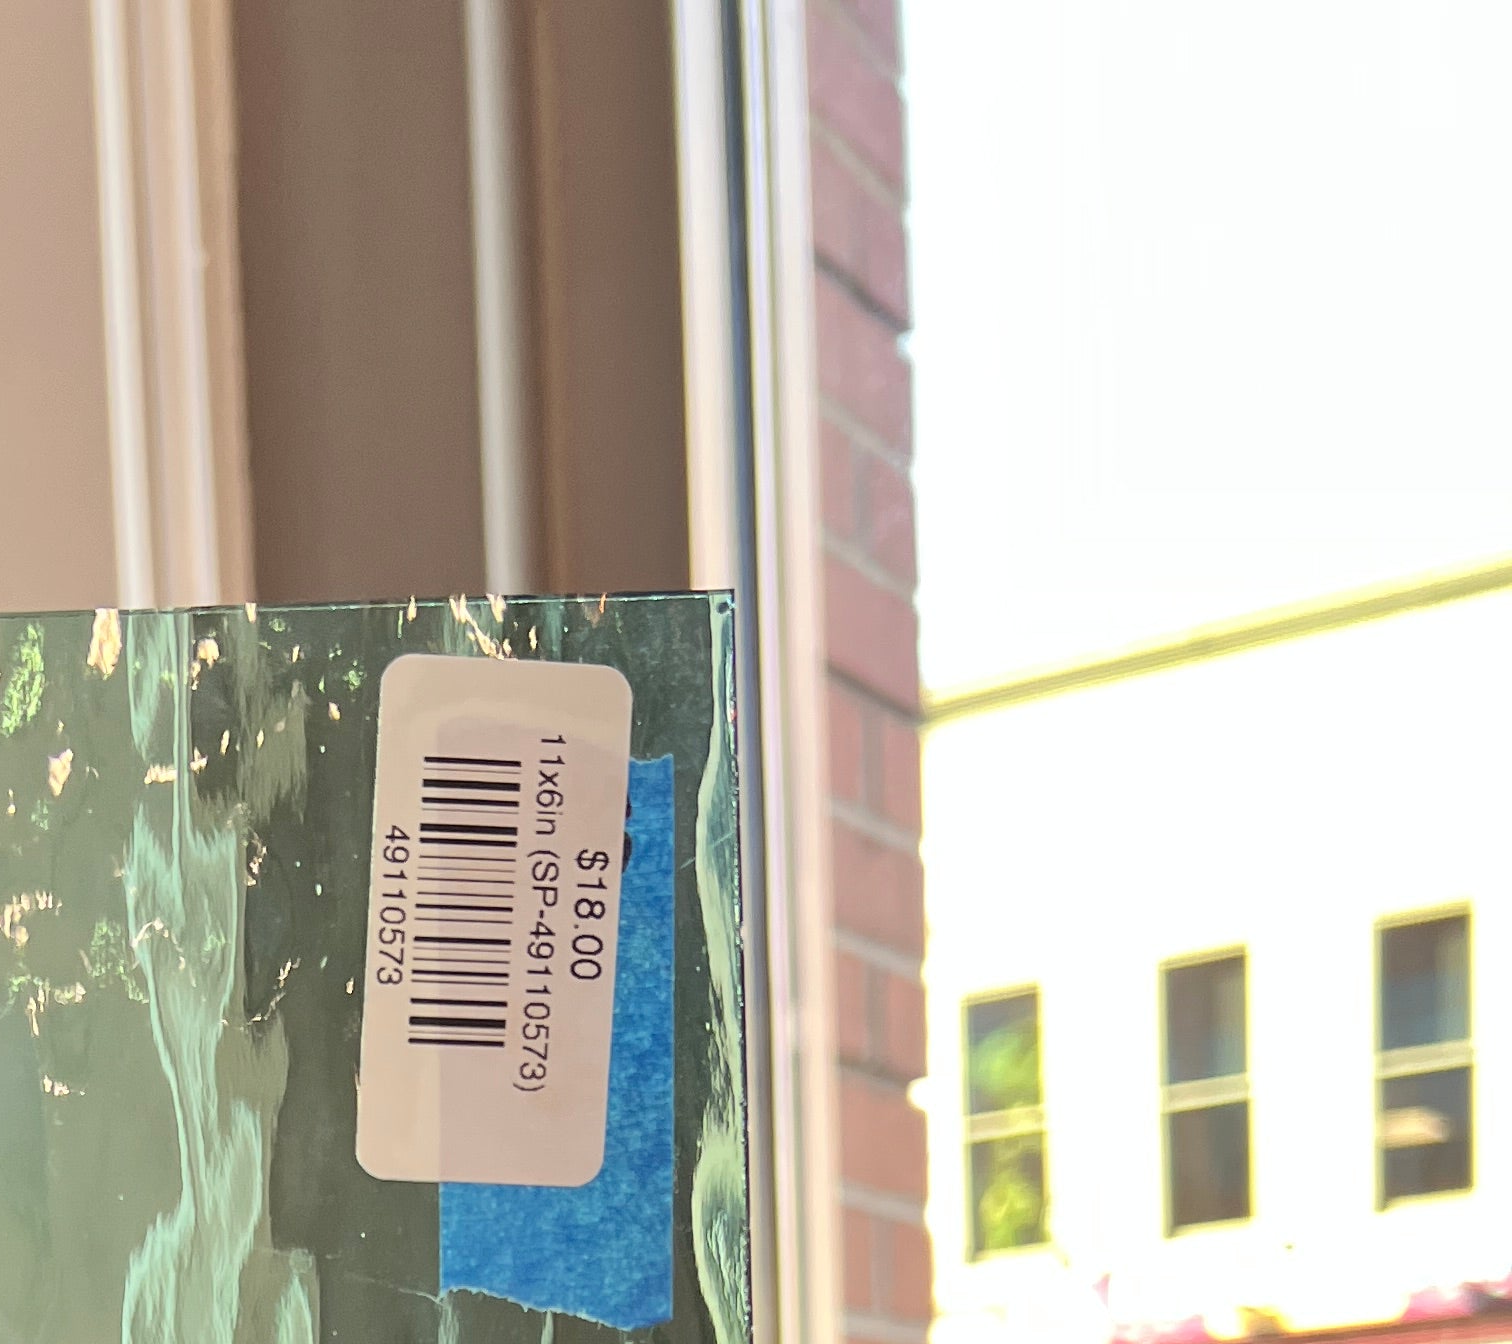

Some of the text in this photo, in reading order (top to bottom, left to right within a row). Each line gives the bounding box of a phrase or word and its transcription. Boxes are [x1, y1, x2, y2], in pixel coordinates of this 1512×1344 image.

[376, 825, 410, 985] 49110573
[513, 734, 566, 1093] 11x6in (SP-49110573)
[570, 849, 609, 981] $18.00
